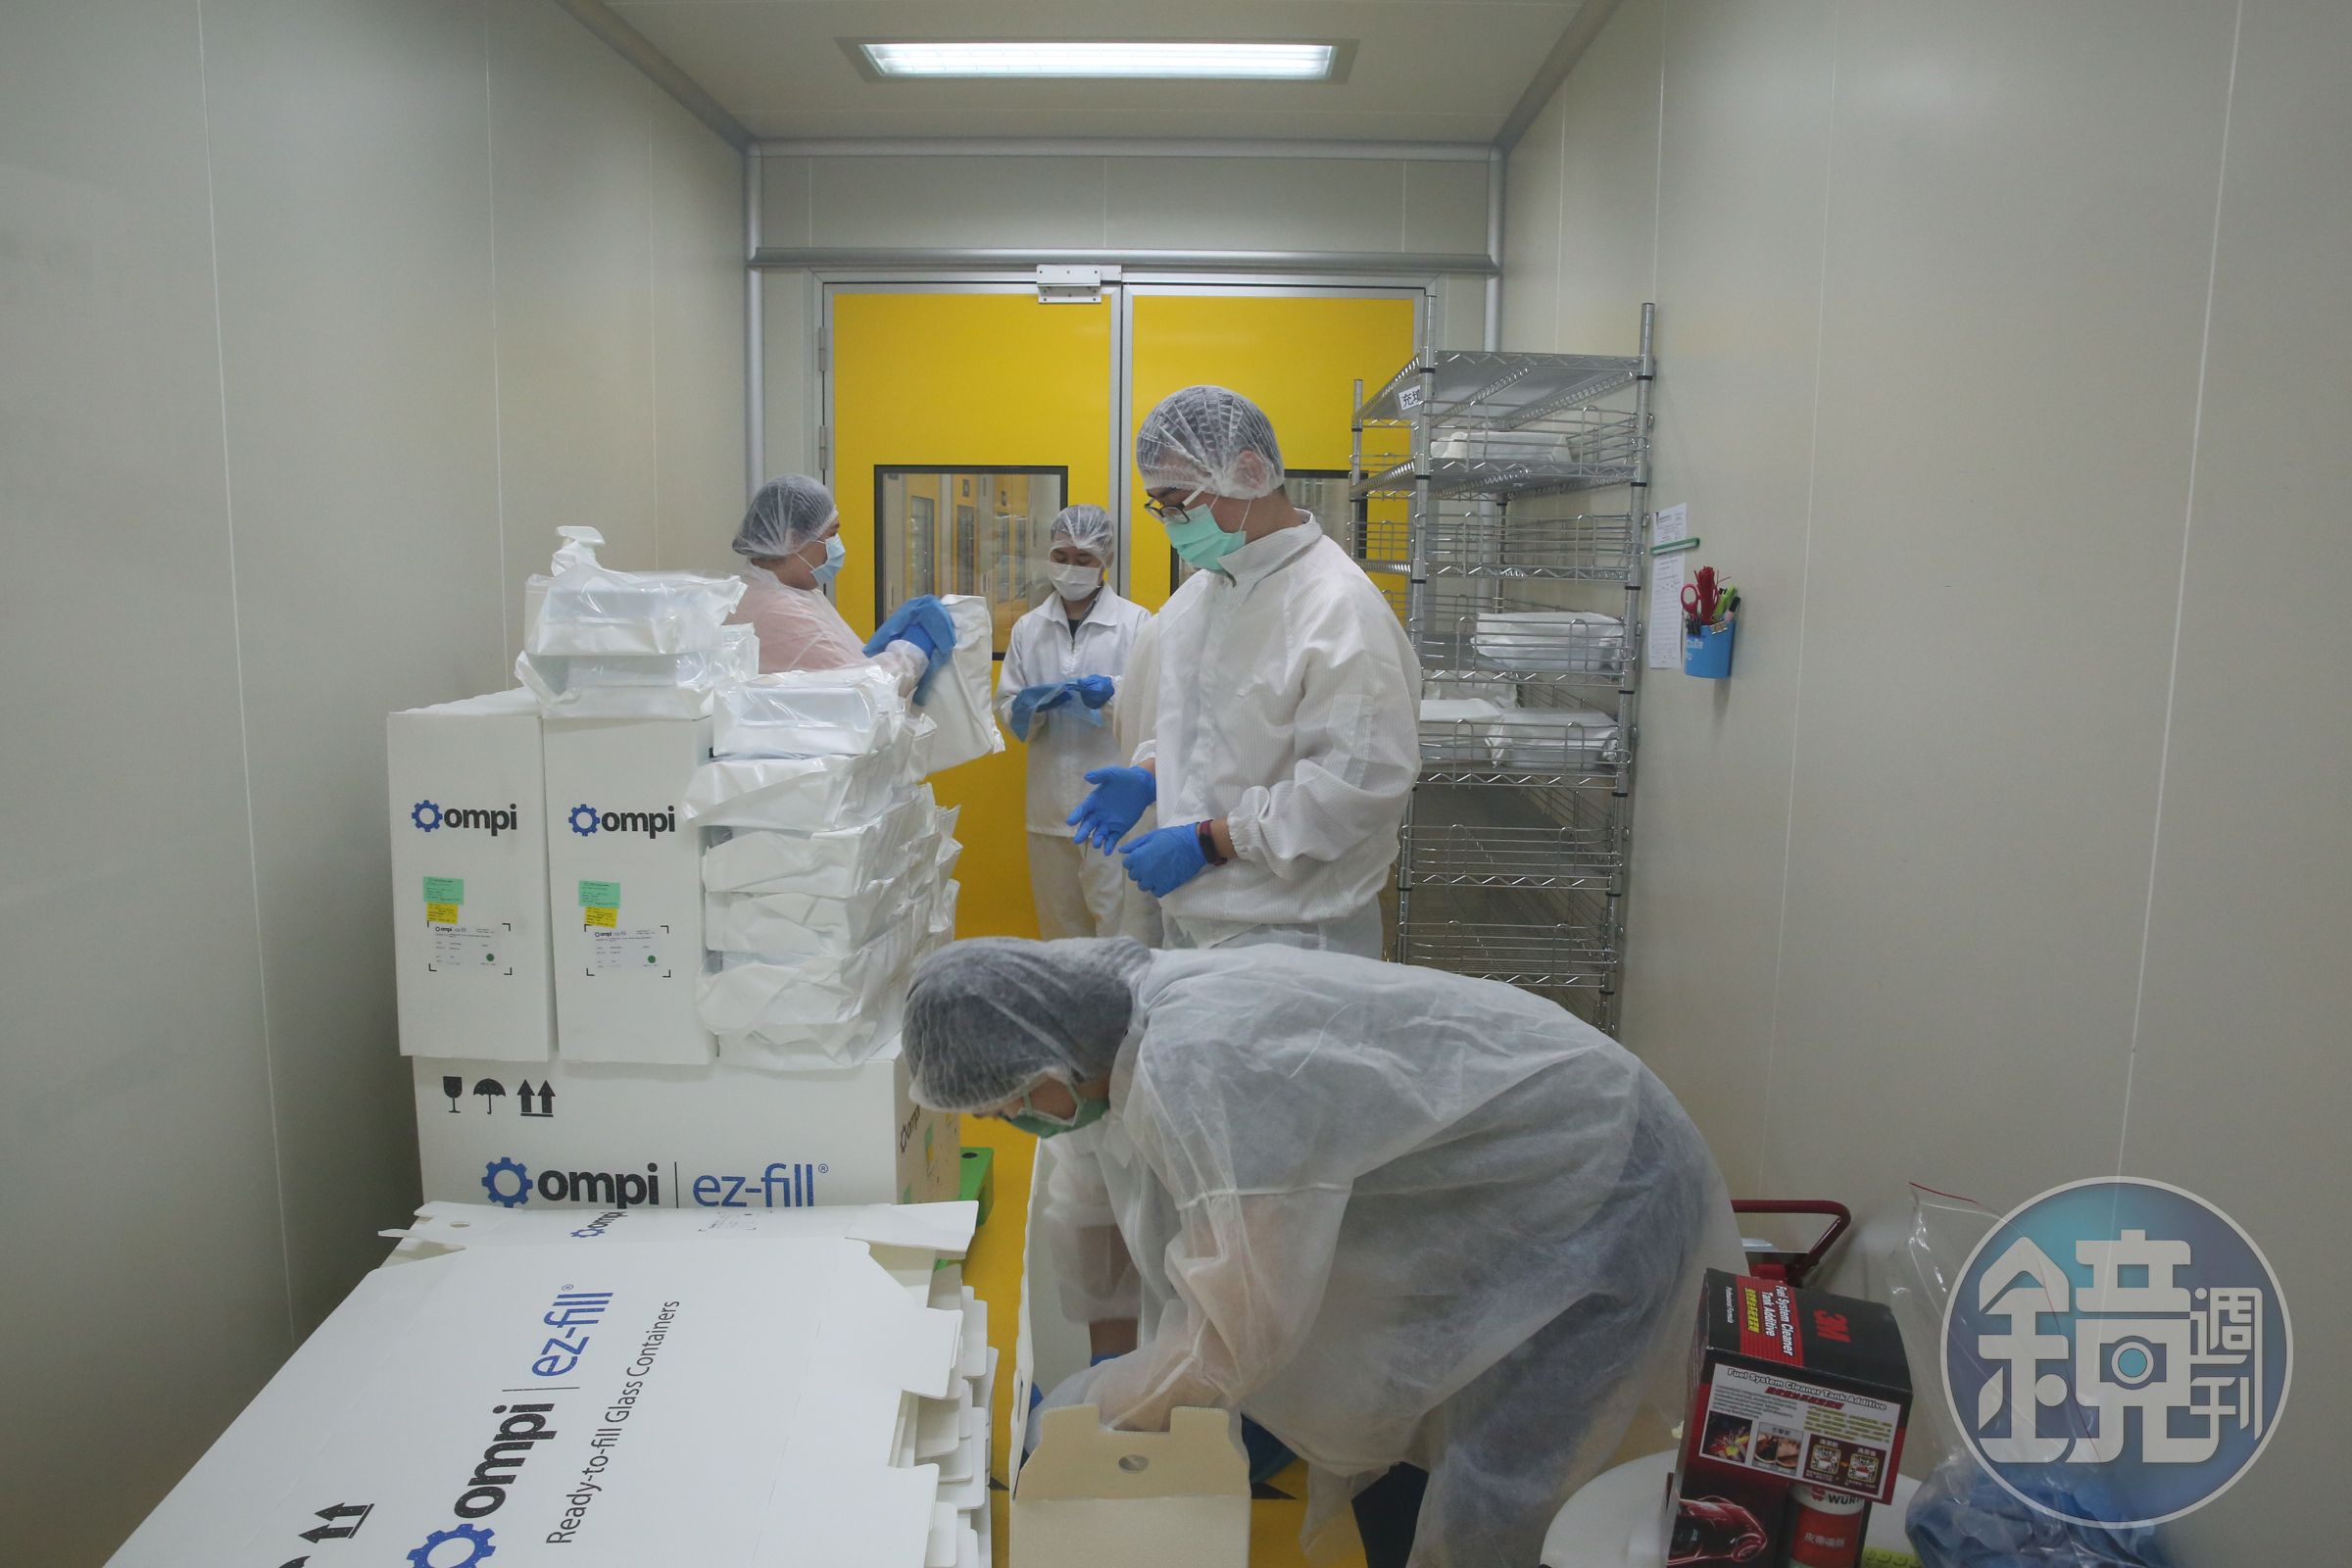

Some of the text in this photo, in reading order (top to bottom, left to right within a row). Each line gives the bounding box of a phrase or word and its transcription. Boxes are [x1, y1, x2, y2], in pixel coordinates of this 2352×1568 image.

[444, 803, 517, 837] ompi
[601, 805, 676, 840] ompi
[537, 1162, 660, 1209] ompi
[1762, 1291, 1778, 1337] Tank Additive
[1776, 1285, 1794, 1356] Fuel System Cleaner
[1814, 1309, 1850, 1343] 3M
[1727, 1367, 1748, 1380] Fuel
[1749, 1373, 1785, 1388] System
[1786, 1382, 1821, 1396] Cleaner
[1822, 1390, 1847, 1401] Tank
[1847, 1396, 1887, 1411] Additive
[545, 1300, 679, 1544] Ready-to-fill Glass Containers
[454, 1403, 558, 1519] ompi
